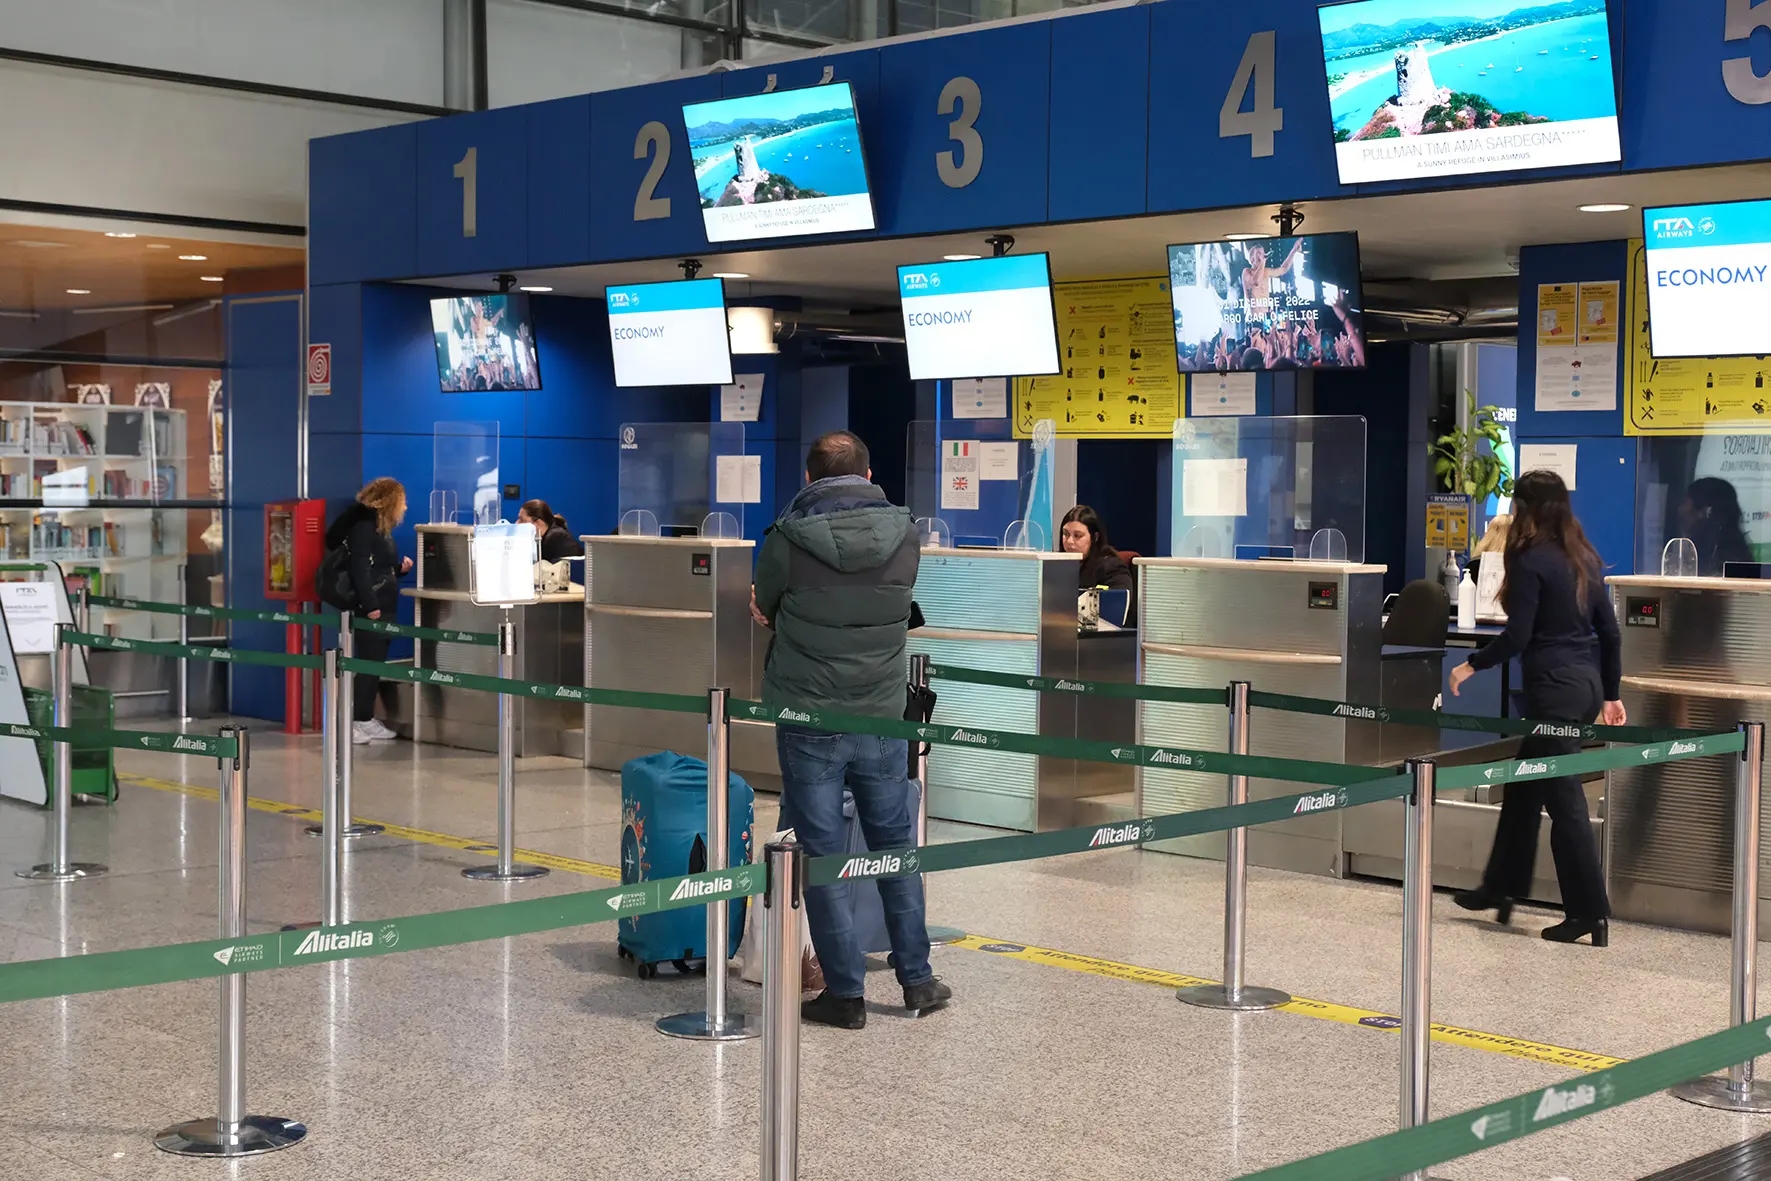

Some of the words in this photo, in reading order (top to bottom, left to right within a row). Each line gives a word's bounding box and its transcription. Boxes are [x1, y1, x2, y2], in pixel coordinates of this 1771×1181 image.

[1722, 0, 1771, 105] 5
[1219, 30, 1283, 158] 4
[936, 76, 983, 189] 3
[1363, 145, 1422, 161] PULLMAN
[1424, 142, 1451, 156] TIMI
[1454, 139, 1483, 153] AMA
[633, 121, 671, 221] 2
[1424, 160, 1446, 168] SUNNY
[453, 147, 477, 237] 1
[1653, 217, 1695, 232] ITA
[1657, 230, 1693, 239] AIRWAYS
[1657, 265, 1768, 287] ECONOMY
[1285, 295, 1311, 307] 2022
[908, 310, 973, 327] ECONOMY
[1218, 313, 1242, 323] ARGO
[1244, 311, 1277, 323] CARLO
[1282, 309, 1319, 321] FELICE
[614, 326, 665, 340] ECONOMY
[1434, 496, 1467, 504] RYANAIR
[430, 670, 454, 683] Alitalia
[555, 686, 582, 699] Alitalia
[1055, 679, 1085, 692] Alitalia
[778, 707, 811, 723] Alitalia
[1332, 703, 1376, 719] Alitalia
[950, 728, 988, 744] Alitalia
[1531, 723, 1580, 738] Alitalia
[172, 736, 207, 751] Alitalia
[1668, 742, 1697, 756] Alitalia
[1150, 749, 1192, 765] Alitalia
[1515, 761, 1548, 776] Alitalia
[1293, 793, 1336, 814] Alitalia
[1089, 825, 1140, 847] Alitalia
[837, 854, 901, 879] Alitalia
[669, 877, 733, 901] Alitalia
[293, 930, 374, 956] Alitalia
[1036, 951, 1131, 971] Attendere
[1431, 1025, 1553, 1053] Attendere
